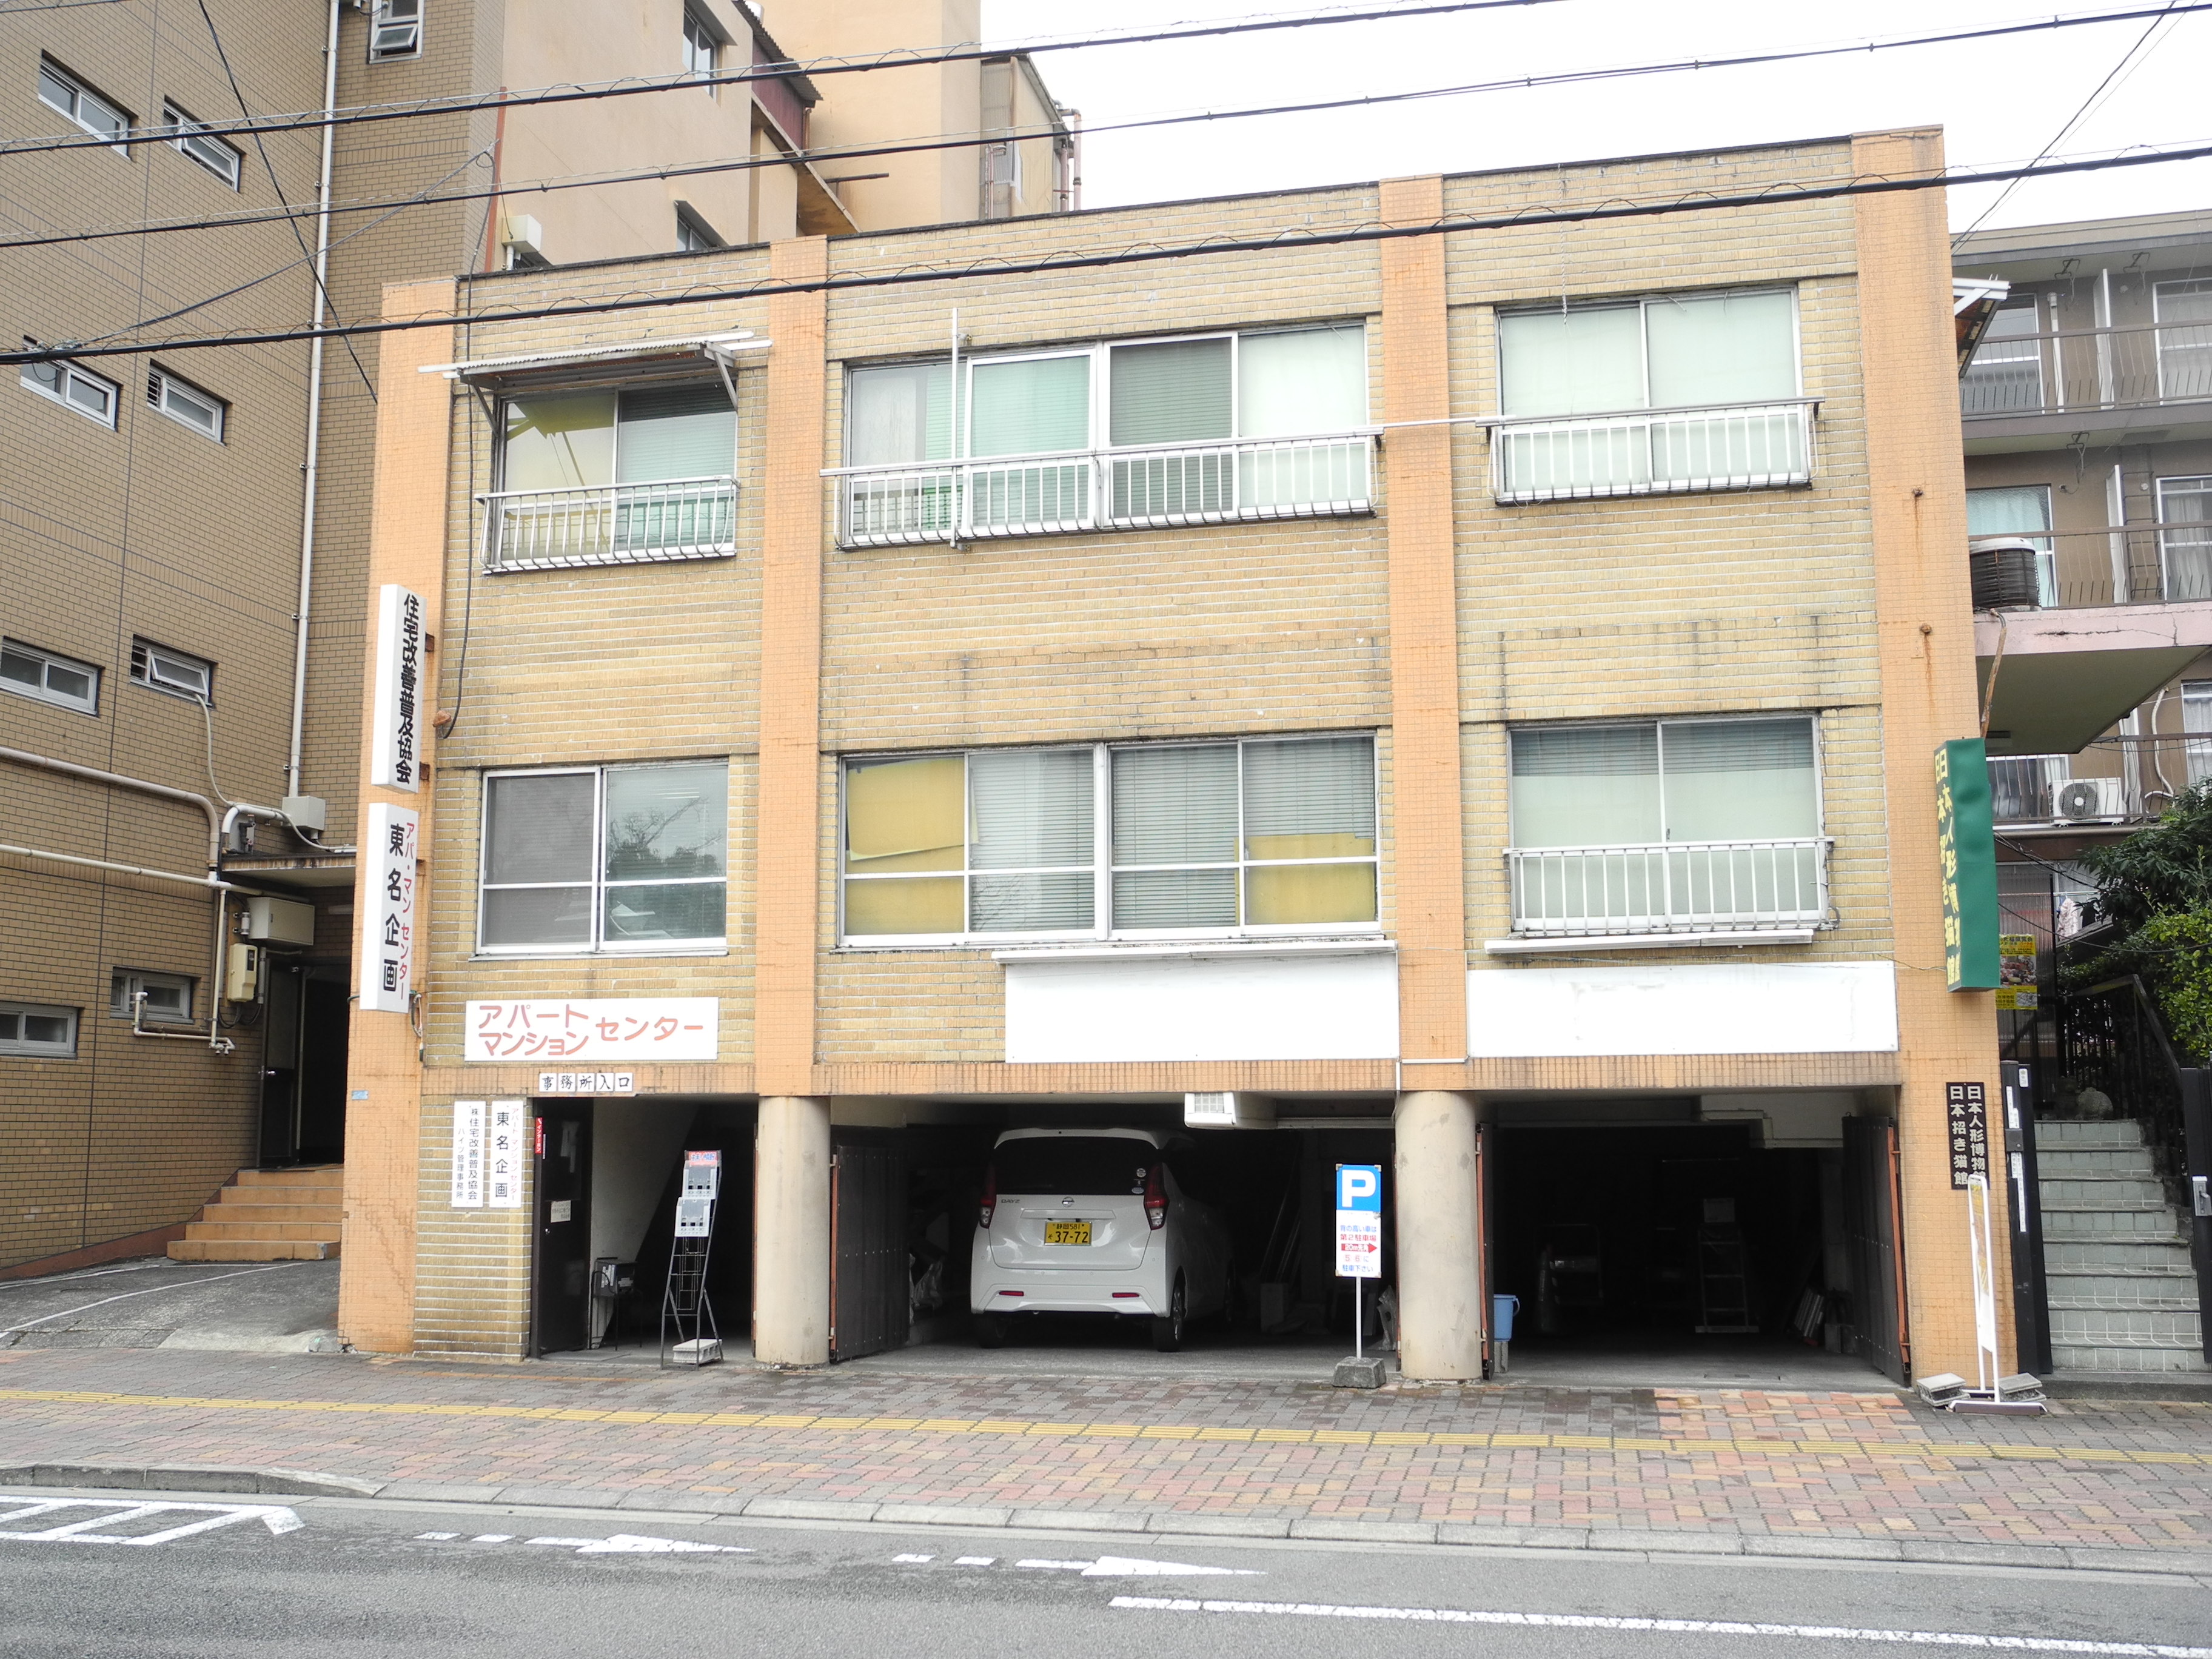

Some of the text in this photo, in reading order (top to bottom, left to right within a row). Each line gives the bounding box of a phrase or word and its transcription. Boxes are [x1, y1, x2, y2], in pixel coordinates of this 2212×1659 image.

[395, 593, 420, 785] 住宅改善普及協会
[383, 823, 405, 991] 東名企画
[478, 1004, 589, 1029] アパート
[595, 1016, 703, 1041] センター
[478, 1032, 589, 1056] マンション
[541, 1075, 630, 1091] 事務所入口
[495, 1111, 509, 1198] 東名企画
[1950, 1086, 1968, 1185] 日本招き猫館
[456, 1128, 465, 1199] ハイツ管理事務所
[1341, 1169, 1376, 1208] P
[1055, 1232, 1088, 1243] 37-72
